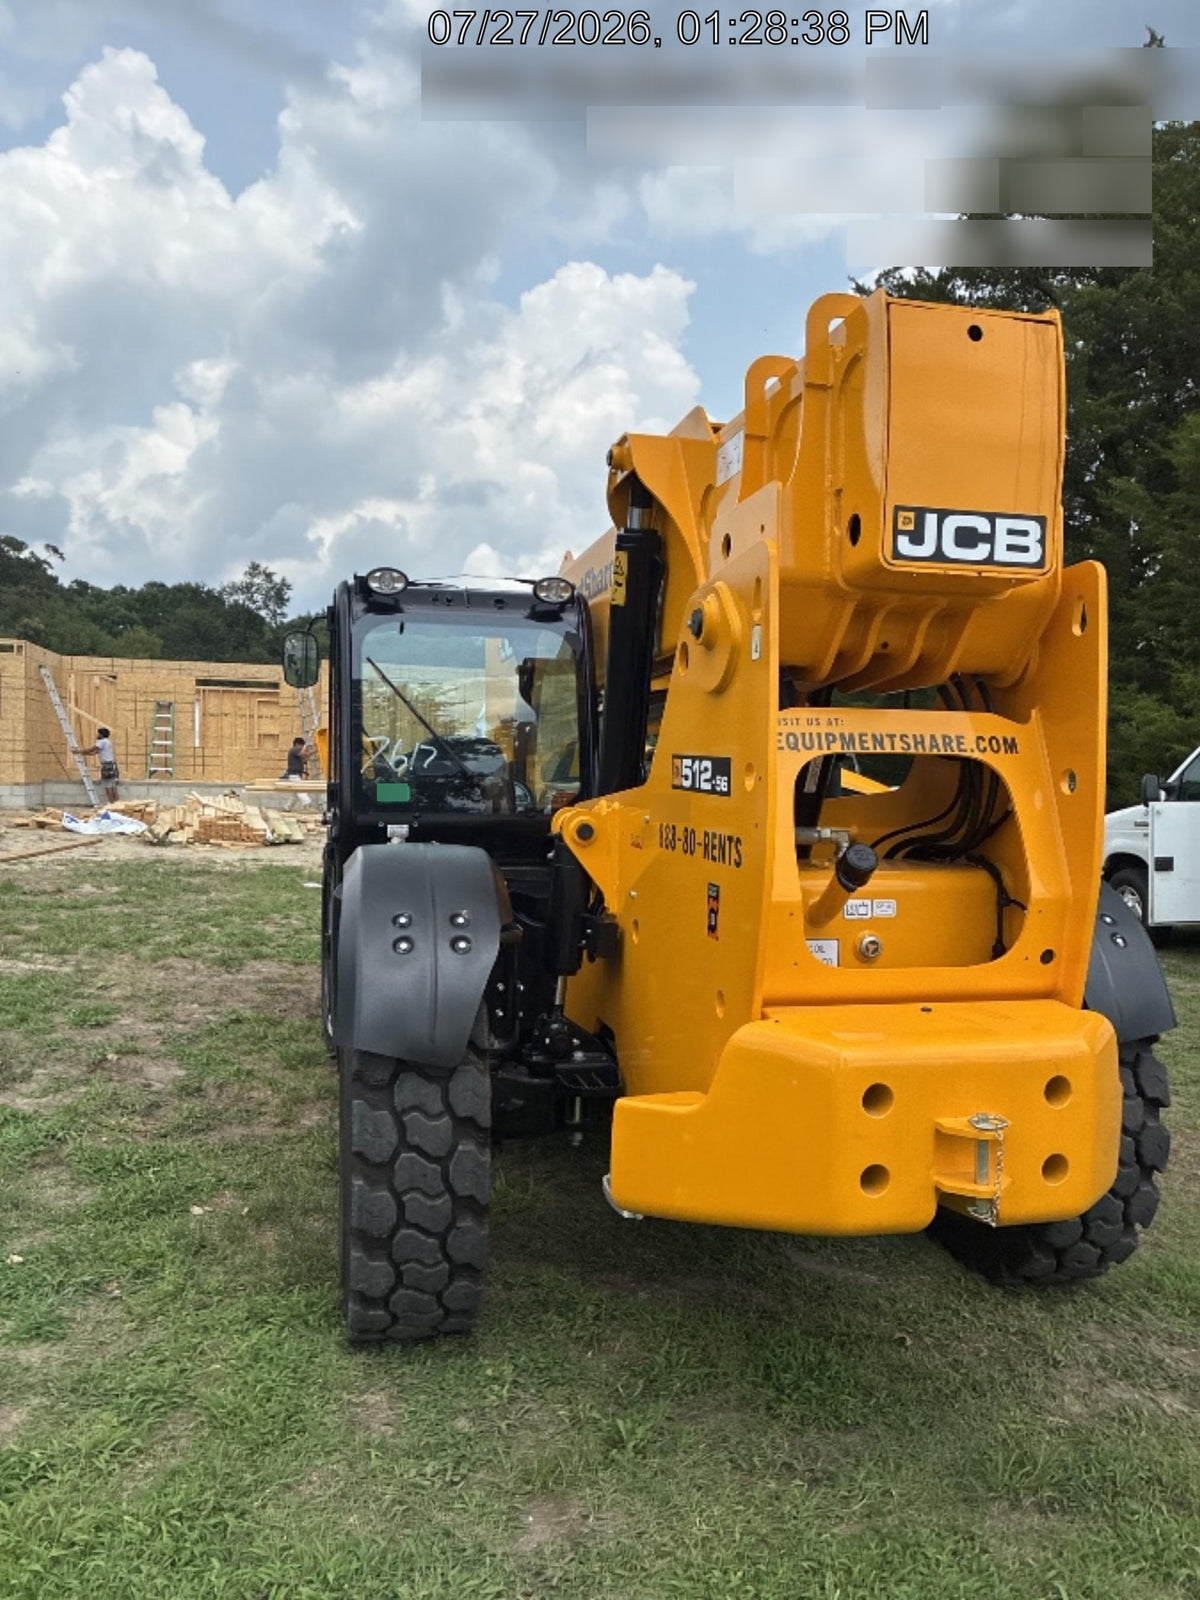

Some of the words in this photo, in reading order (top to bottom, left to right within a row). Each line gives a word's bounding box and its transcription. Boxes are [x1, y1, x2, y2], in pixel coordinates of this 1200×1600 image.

[897, 512, 1043, 564] JCB
[807, 717, 821, 726] US
[827, 717, 844, 727] AT:
[777, 731, 1019, 755] EQUIPMENTSHARE.COM
